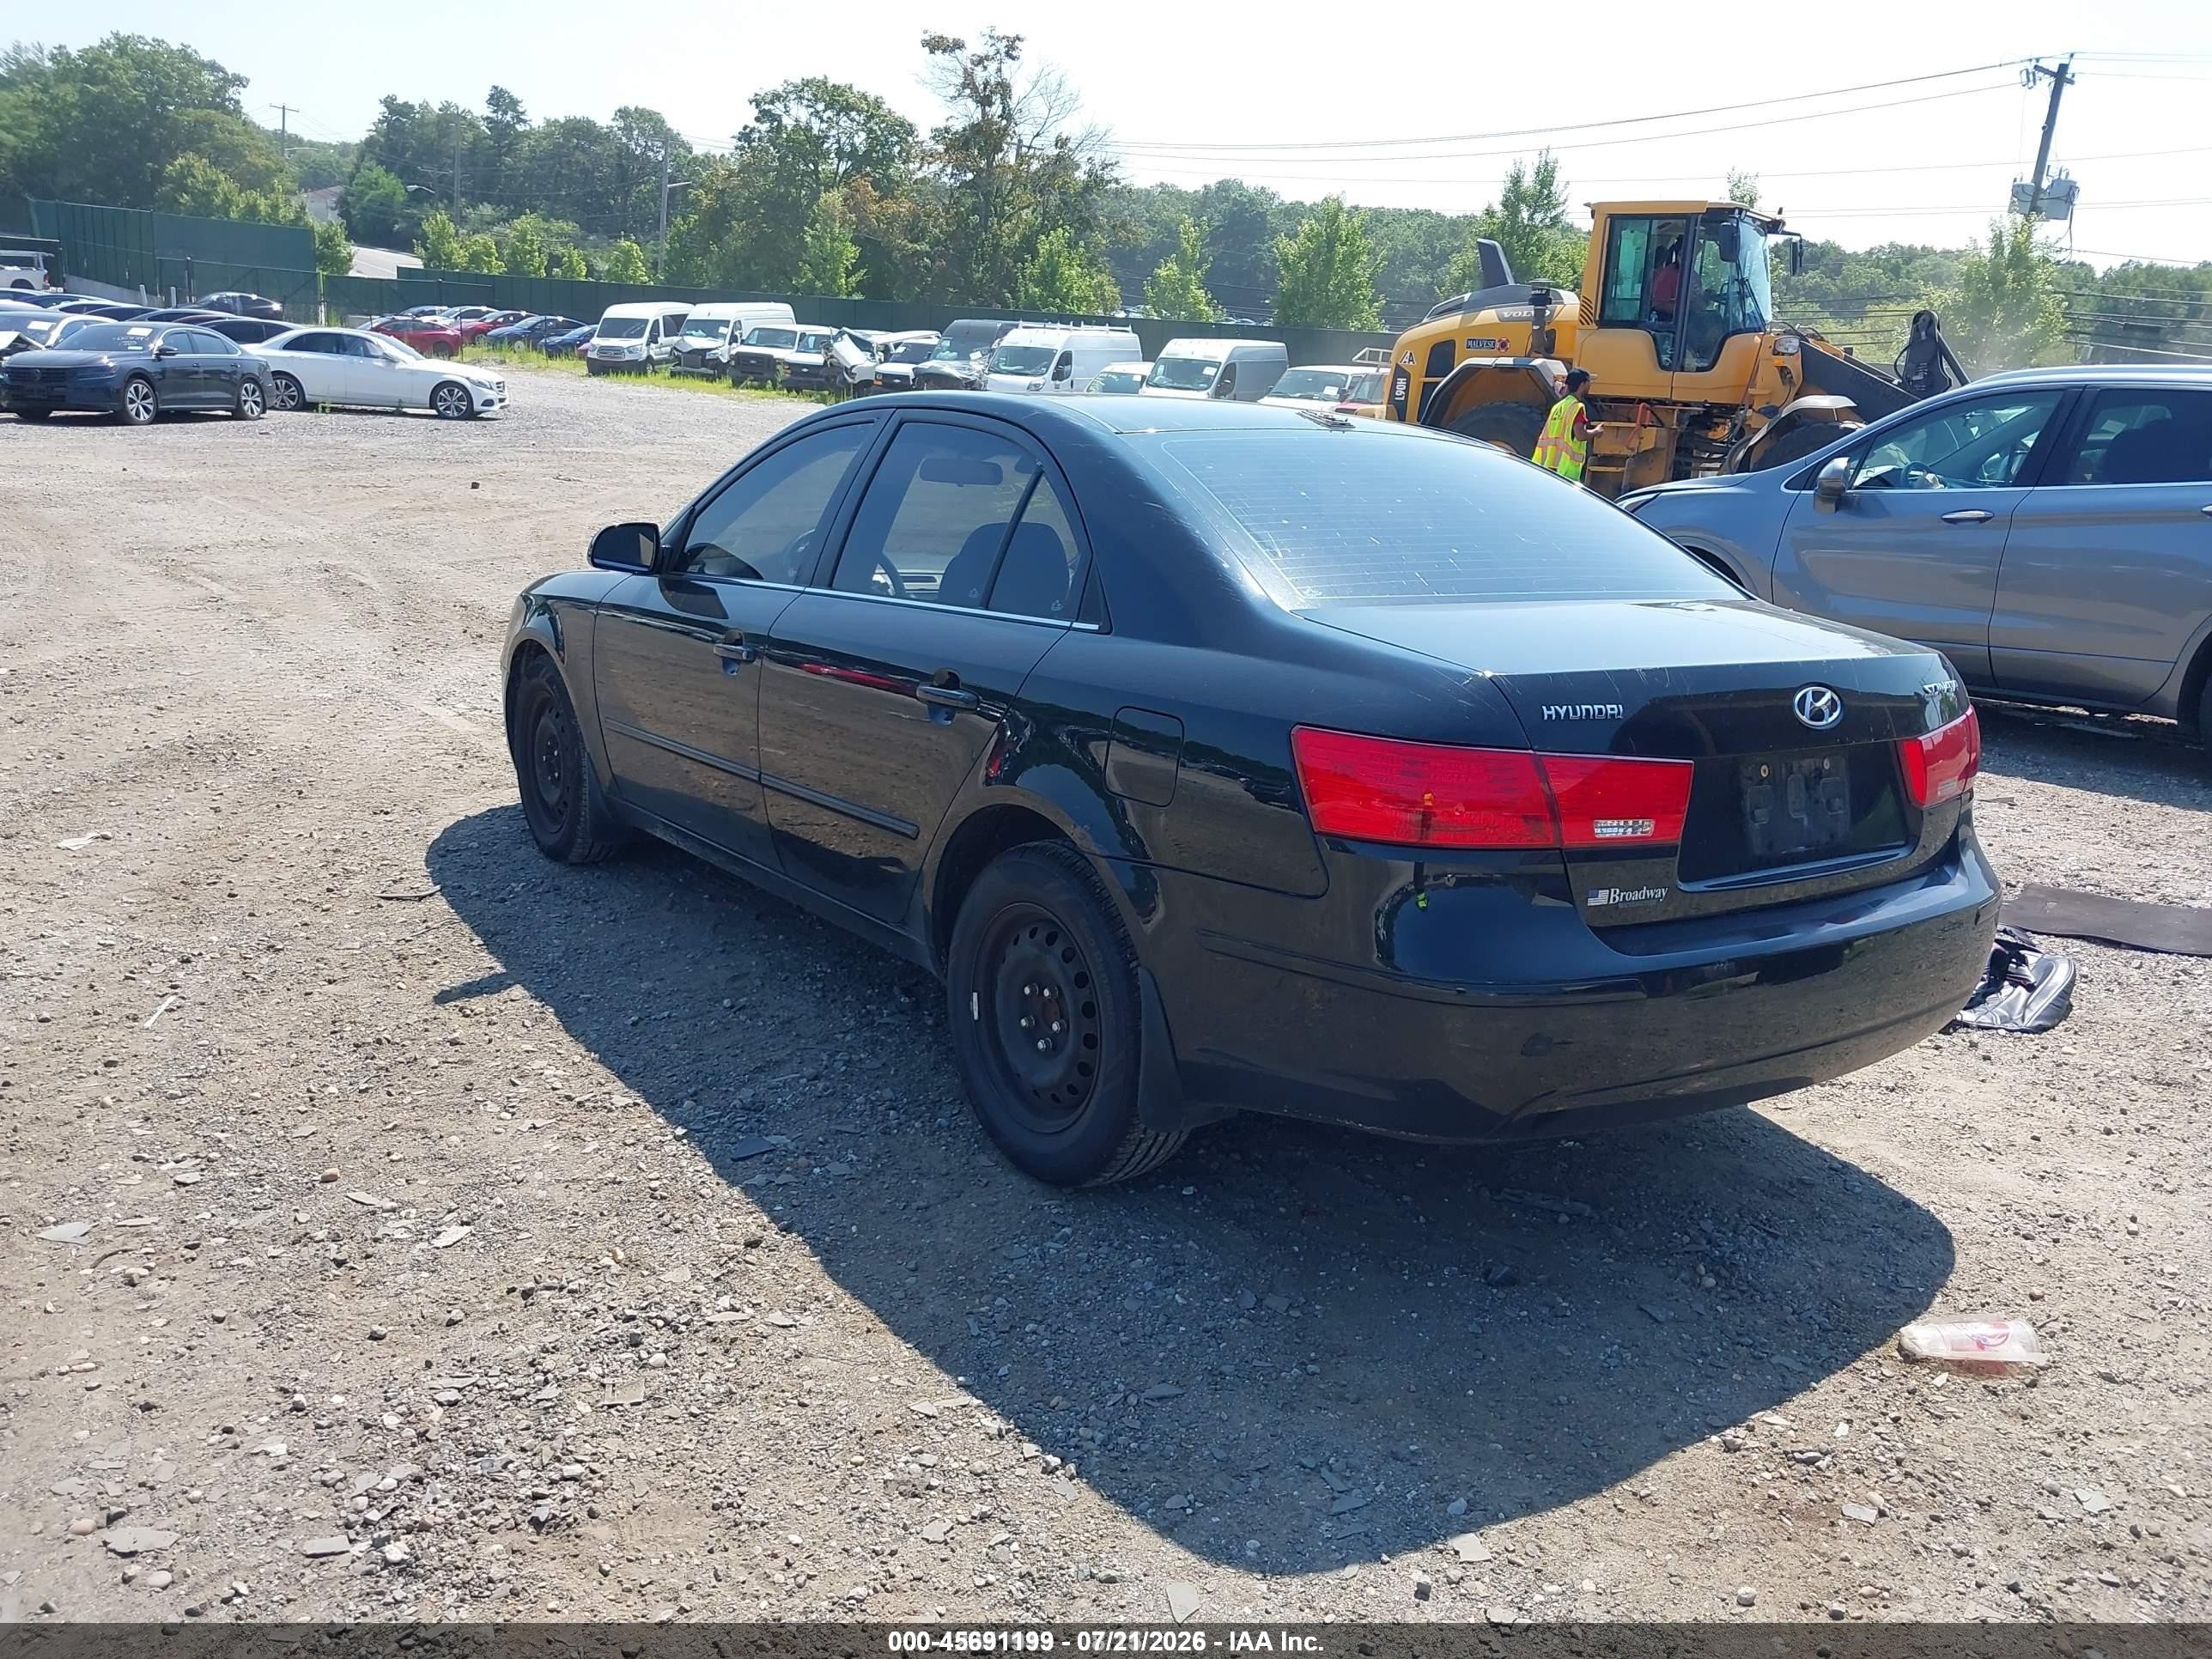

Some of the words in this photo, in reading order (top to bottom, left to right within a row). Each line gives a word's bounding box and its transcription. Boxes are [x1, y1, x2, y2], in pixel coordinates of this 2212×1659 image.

[1467, 339, 1495, 349] MALVESE
[1394, 377, 1407, 401] L90H
[1541, 703, 1625, 720] HYUNDAI
[1608, 885, 1668, 904] Broadway
